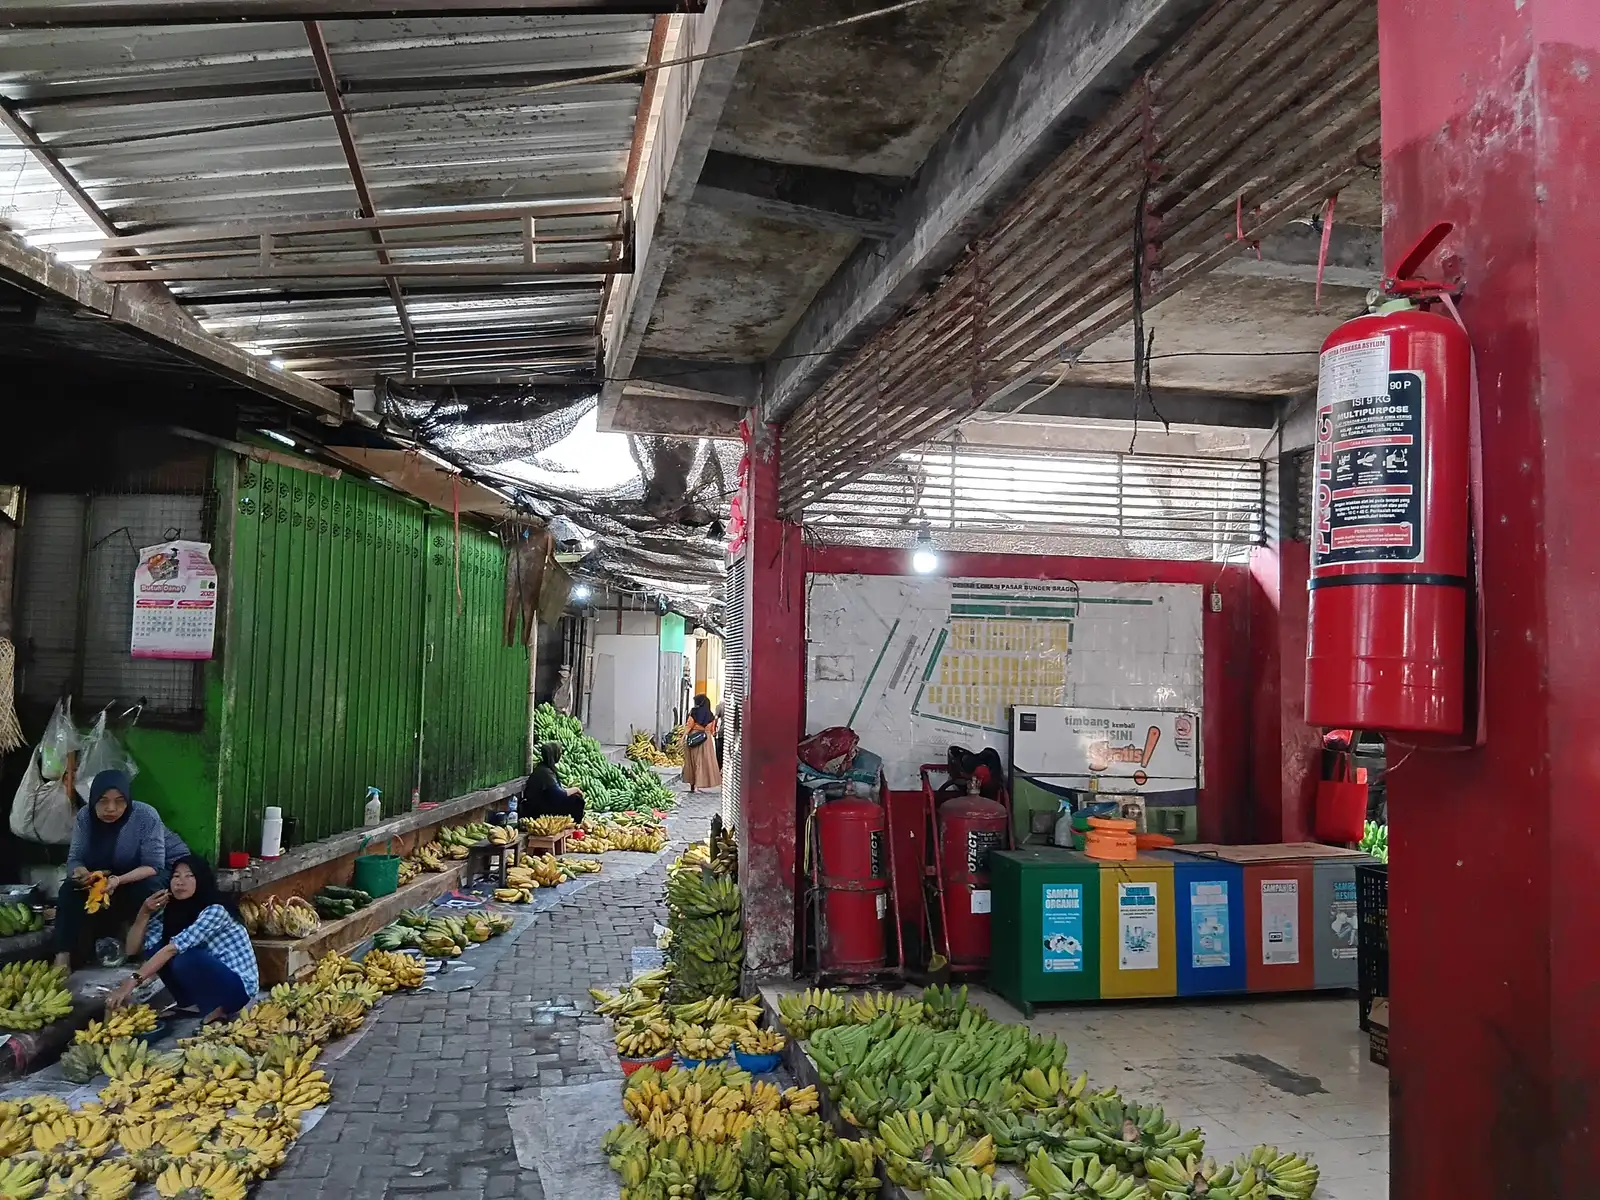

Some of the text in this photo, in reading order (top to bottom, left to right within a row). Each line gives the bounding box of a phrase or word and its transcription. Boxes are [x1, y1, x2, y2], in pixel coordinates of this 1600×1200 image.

[1362, 340, 1386, 349] ASYLUM
[1389, 381, 1412, 390] 90 P
[1366, 396, 1373, 405] 9
[1375, 394, 1391, 404] KG
[1337, 406, 1409, 420] MULTIPURPOSE
[1064, 716, 1110, 728] timbang
[1046, 888, 1078, 898] SAMPAH
[1263, 884, 1288, 893] SAMPAH
[1045, 899, 1080, 909] ORGANIK
